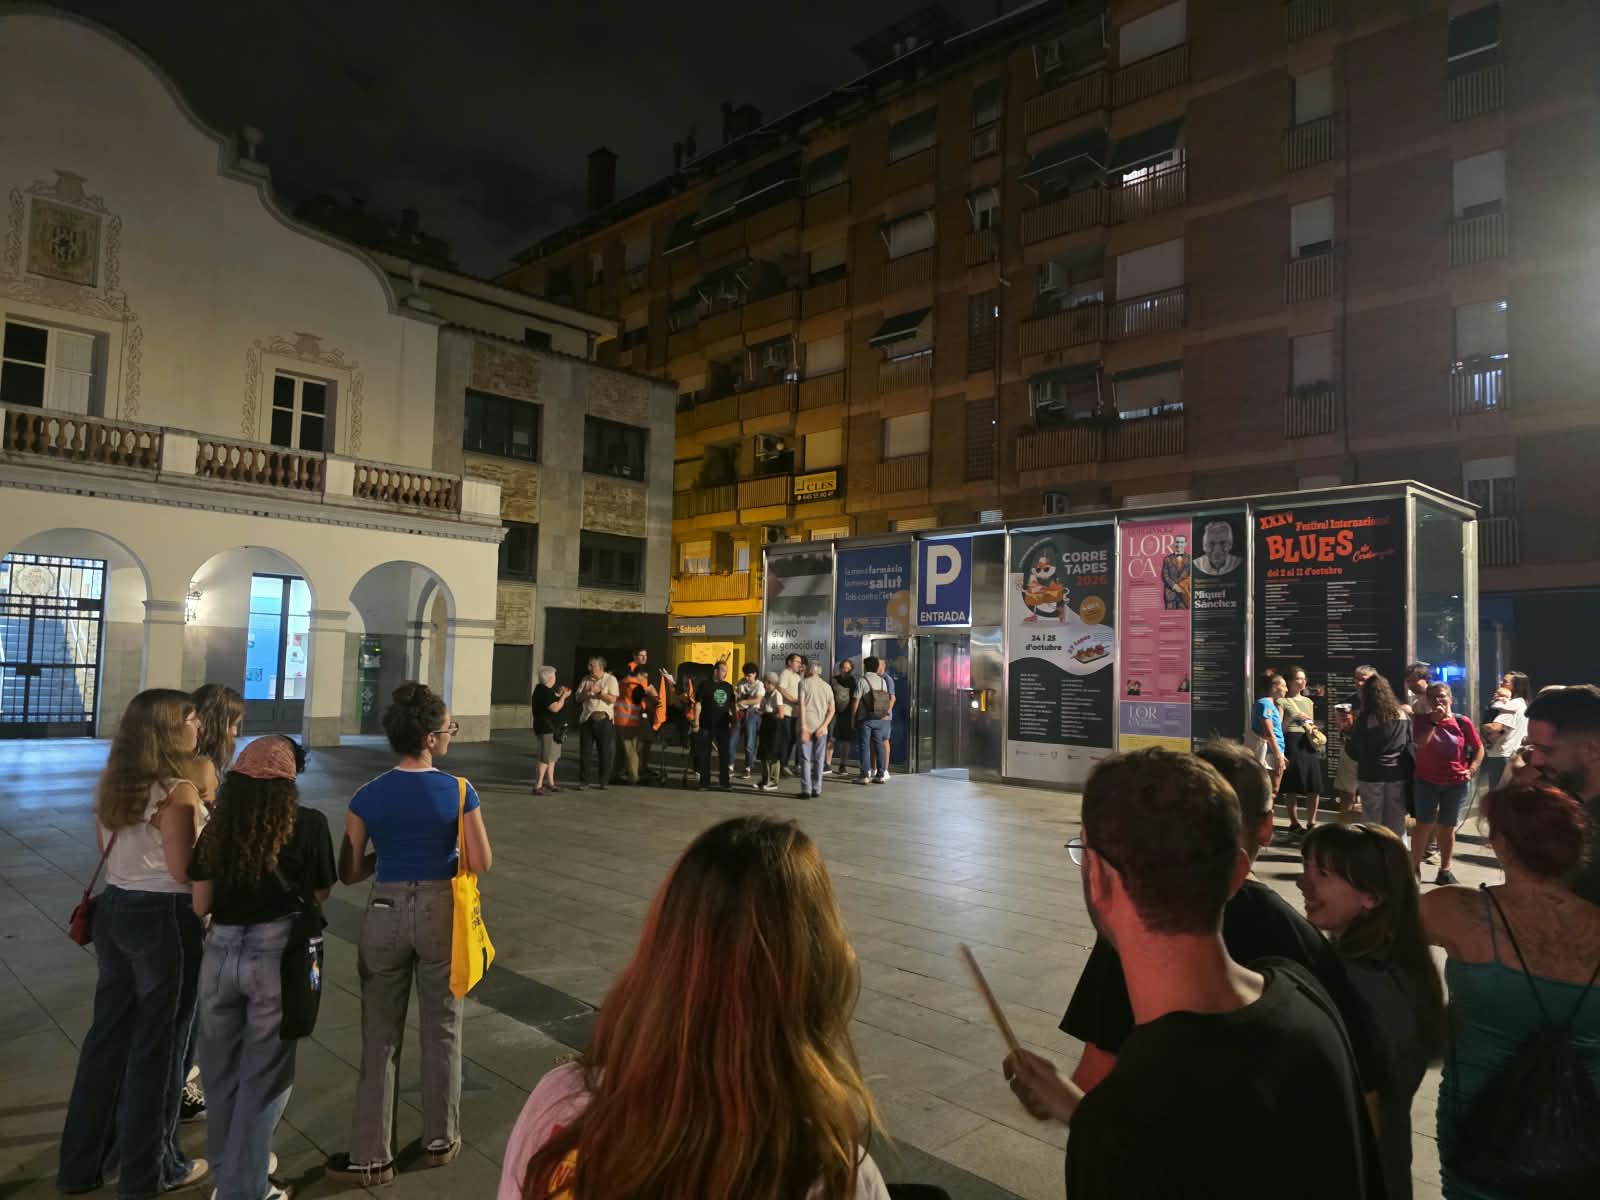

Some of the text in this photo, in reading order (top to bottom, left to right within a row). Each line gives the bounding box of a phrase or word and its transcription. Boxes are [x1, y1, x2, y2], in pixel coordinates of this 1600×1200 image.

[1296, 520, 1328, 531] Festival
[1128, 534, 1176, 557] LOR
[1266, 529, 1354, 563] BLUES
[1062, 550, 1108, 562] CORRE
[1064, 562, 1109, 575] TAPES
[1128, 558, 1158, 579] CA
[926, 544, 962, 605] P
[869, 574, 903, 589] salut
[1194, 589, 1227, 600] Miquel
[1194, 600, 1238, 609] Sánchez
[920, 611, 966, 622] ENTRADA
[772, 629, 798, 638] diu NO
[771, 640, 827, 651] al genocidi del
[1025, 643, 1062, 651] d'octubre
